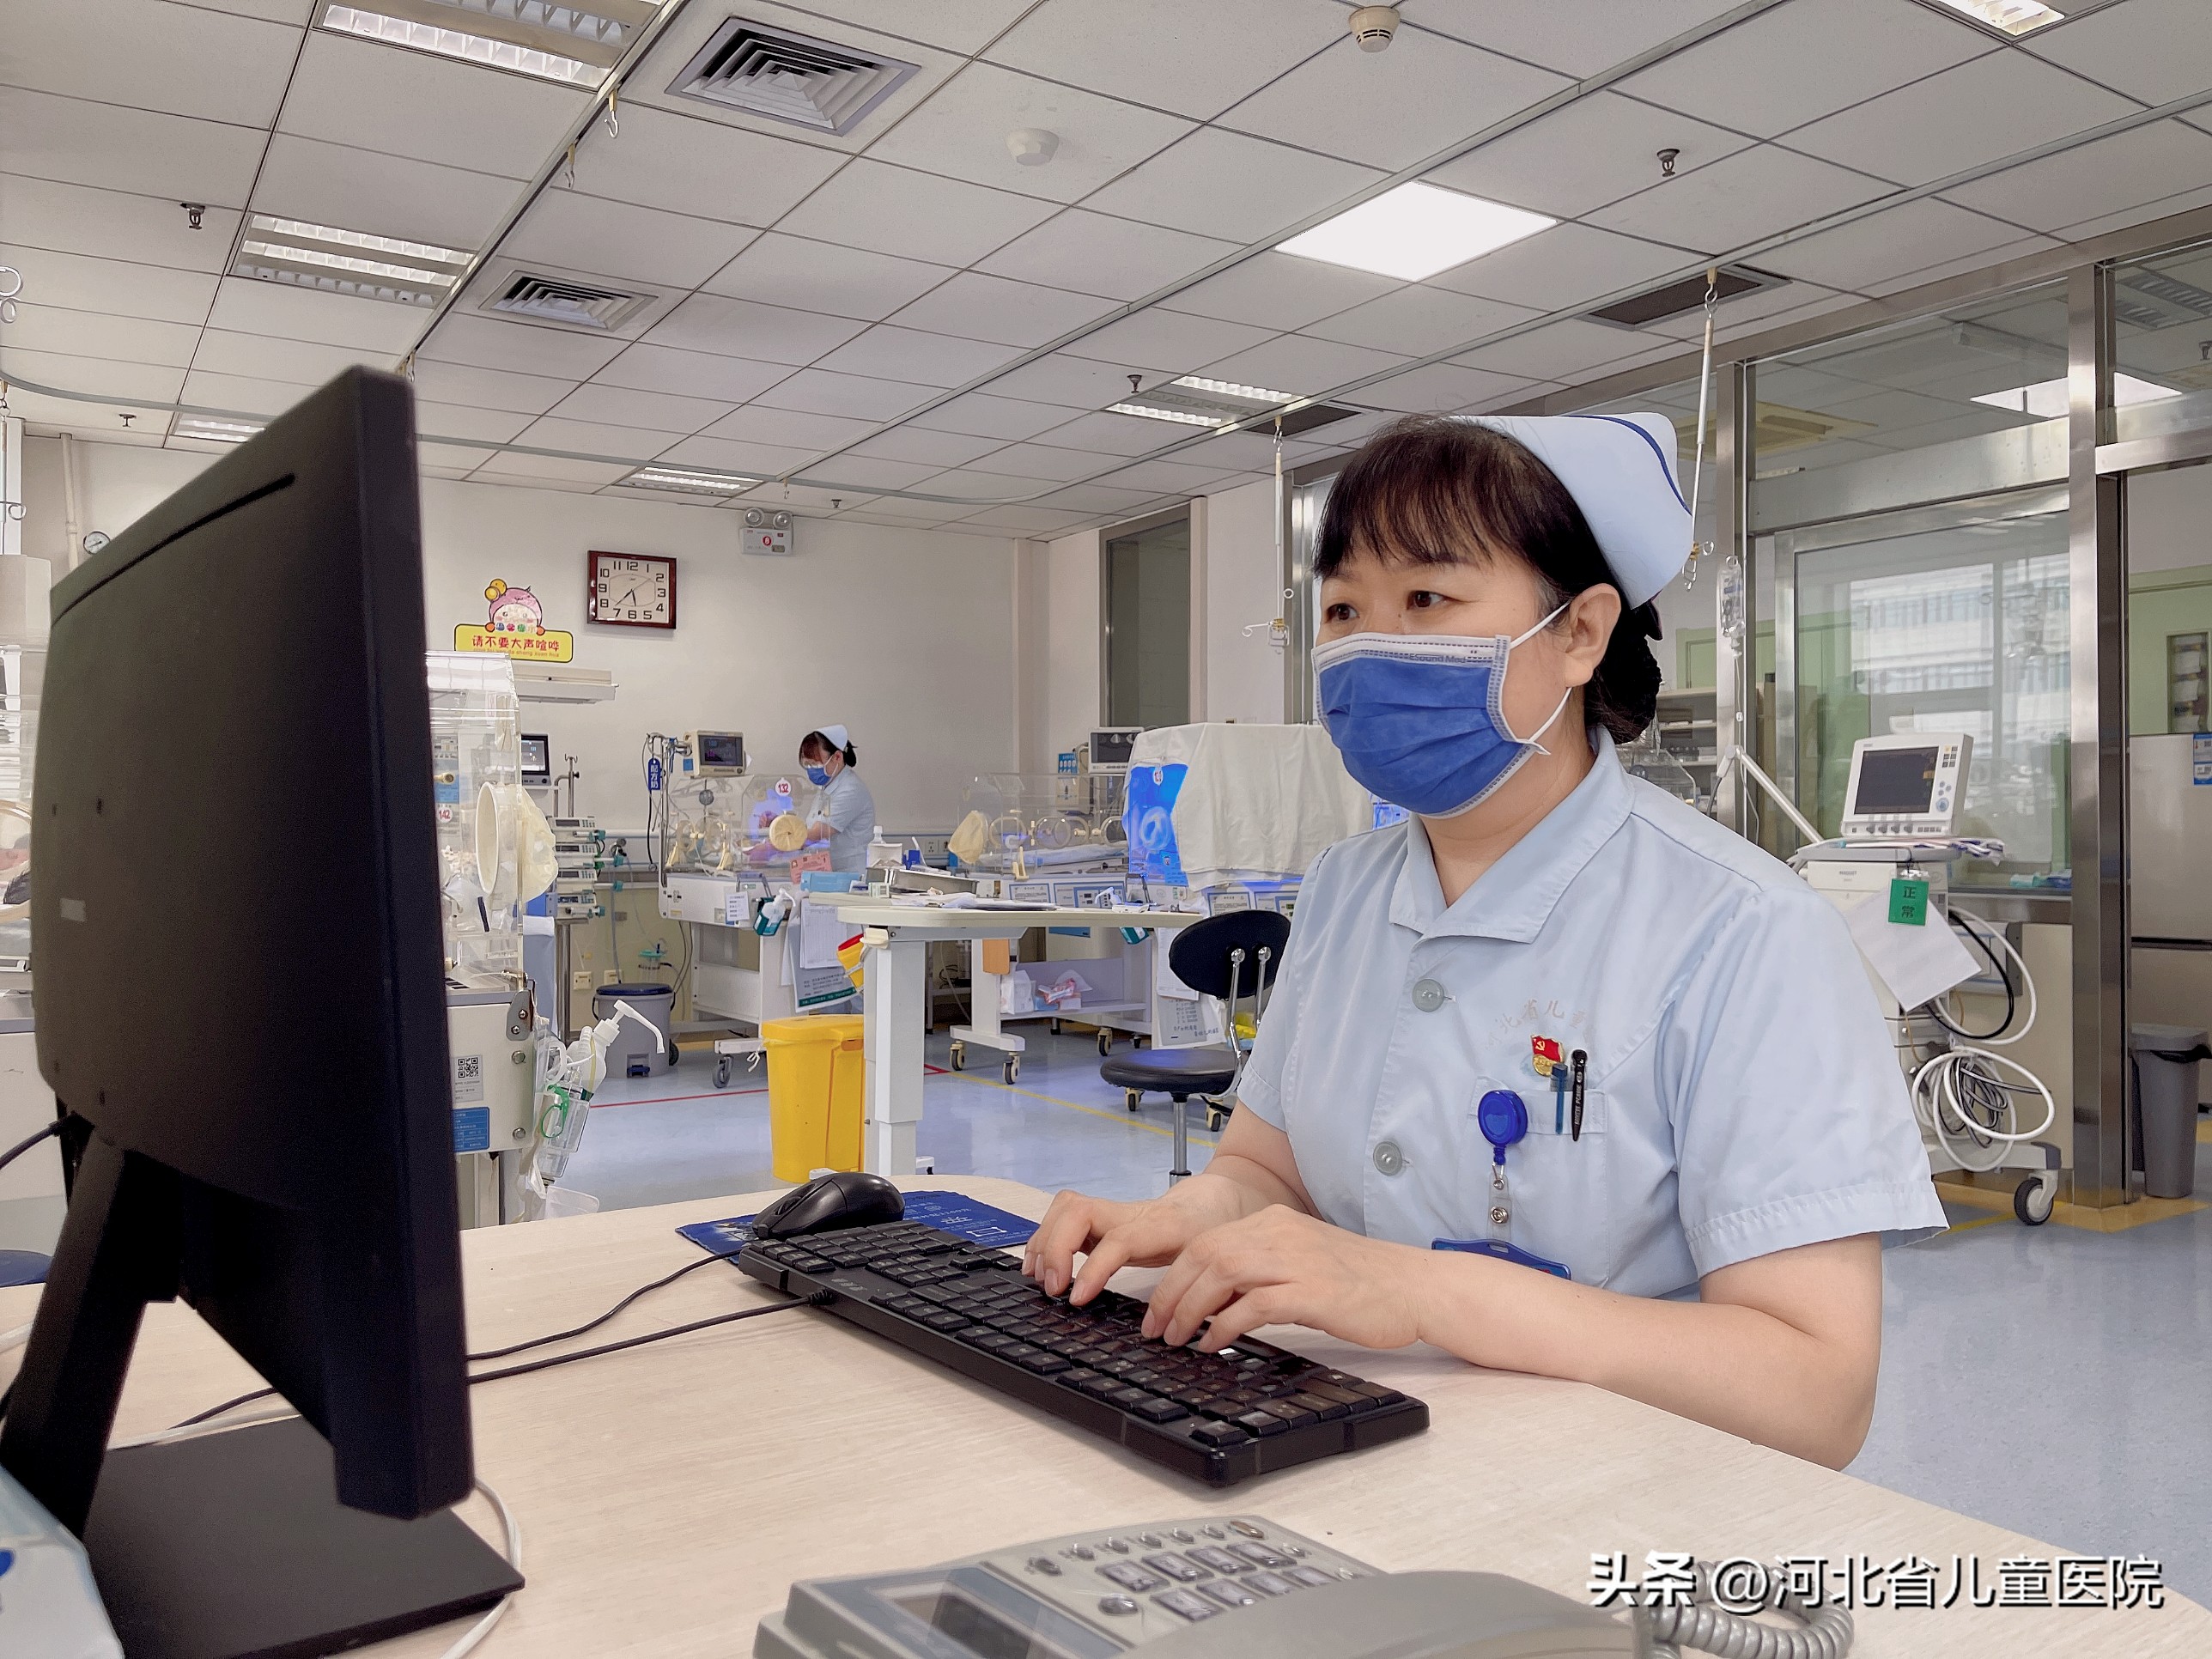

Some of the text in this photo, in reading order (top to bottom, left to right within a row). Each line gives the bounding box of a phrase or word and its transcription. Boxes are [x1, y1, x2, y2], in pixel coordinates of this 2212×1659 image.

[613, 561, 621, 570] 11
[626, 561, 638, 571] 12
[599, 568, 610, 578] 10
[655, 573, 664, 582] 2
[599, 583, 607, 592] 9
[657, 588, 665, 598] 3
[599, 599, 608, 608] 8
[655, 603, 664, 612] 4
[612, 608, 621, 617] 7
[628, 610, 636, 619] 6
[643, 611, 652, 620] 5
[472, 635, 560, 652] 请不要大声喧哗
[778, 783, 789, 793] 132
[439, 810, 451, 820] 142
[1901, 885, 1917, 918] 正常
